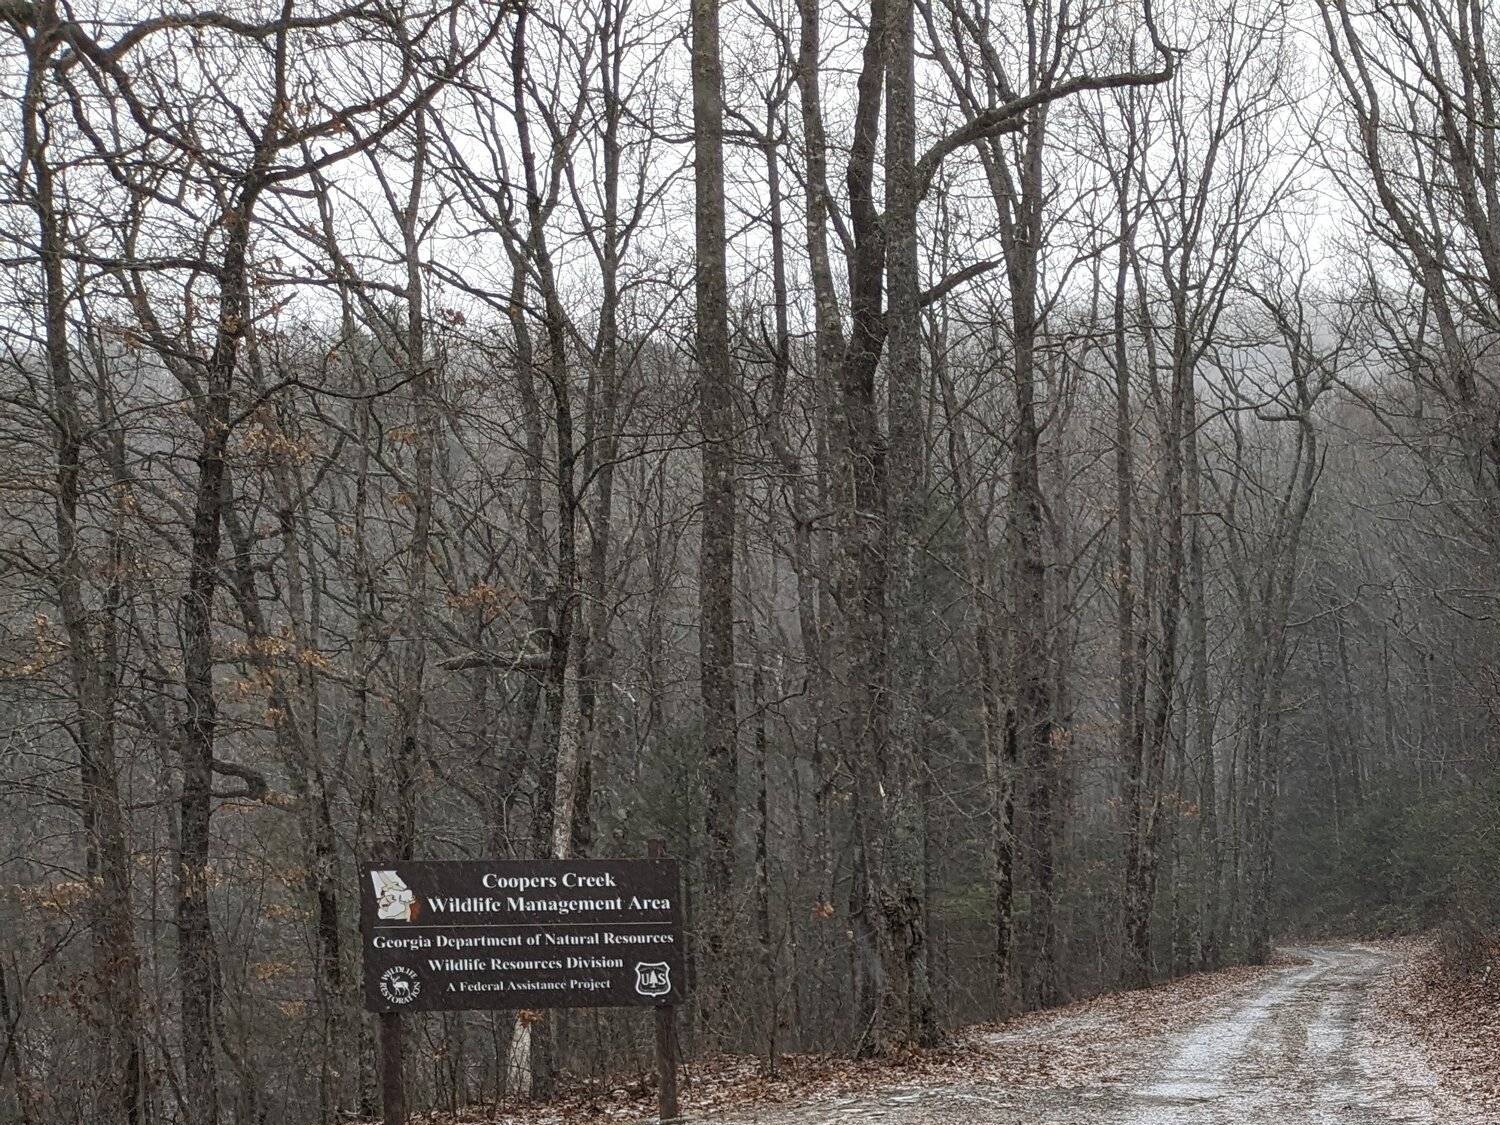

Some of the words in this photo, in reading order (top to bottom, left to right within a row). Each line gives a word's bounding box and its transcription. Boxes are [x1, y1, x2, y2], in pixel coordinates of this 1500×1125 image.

[482, 873, 557, 892] Coopers
[562, 872, 617, 888] Creek
[427, 896, 501, 913] Wildlife
[506, 896, 622, 915] Management
[628, 895, 671, 911] Area
[373, 935, 432, 951] Georgia
[436, 935, 522, 950] Department
[526, 934, 541, 946] of
[545, 932, 600, 945] Natural
[604, 932, 674, 945] Resources
[428, 958, 487, 972] Wildlife
[490, 957, 562, 971] Resources
[566, 956, 624, 969] Division
[446, 982, 456, 992] A
[460, 980, 504, 992] Federal
[507, 980, 567, 992] Assistance
[570, 978, 611, 991] Project
